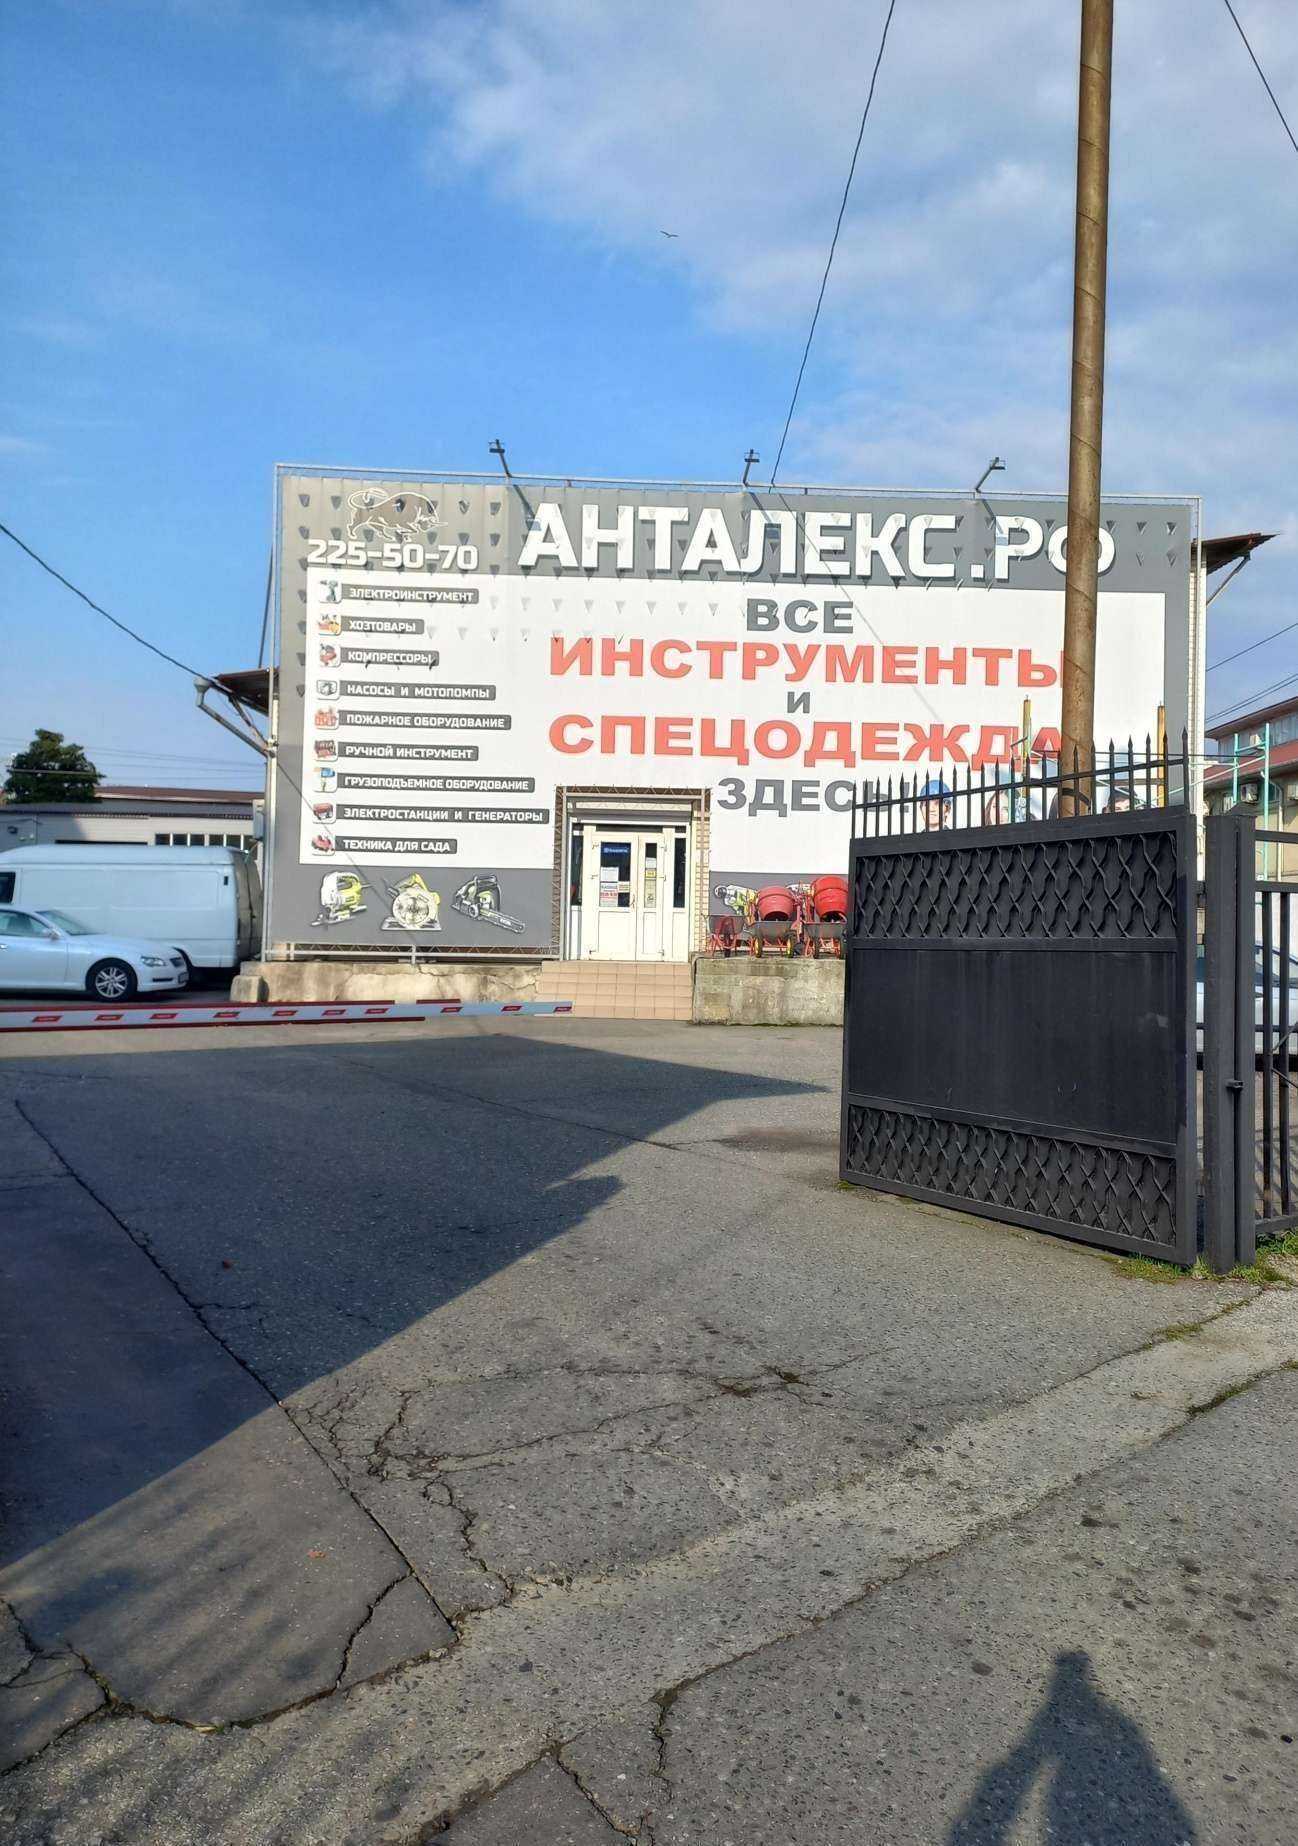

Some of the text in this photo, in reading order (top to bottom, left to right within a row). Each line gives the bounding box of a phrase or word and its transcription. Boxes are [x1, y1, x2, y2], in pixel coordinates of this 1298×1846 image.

[307, 539, 478, 570] 225-50-70
[349, 587, 474, 602] ЭЛЕКТРОИНСТРУМЕНТ
[746, 598, 854, 634] ВСЕ
[349, 619, 417, 633] ХОЗТОВАРЫ
[347, 650, 433, 664] КОМПРЕССОРЫ
[550, 636, 1065, 688] ИНСТРУМЕНТЫ
[347, 684, 490, 699] НАСОСЫ И МОТОПОМПЫ
[786, 691, 811, 714] И
[346, 713, 505, 729] ПОЖАРНОЕ ОБОРУДОВАНИЕ
[548, 714, 1062, 772] СПЕЦОДЕЖДА
[345, 745, 474, 760] РУЧНОЙ ИНСТРУМЕНТ
[344, 776, 529, 792] ГРУЗОПОДЪЕМНОЕ ОБОРУДОВАНИЕ
[343, 807, 543, 822] ЭЛЕКТРОСТАНЦИИ И ГЕНЕРАТОРЫ
[343, 839, 450, 853] ТЕХНИКА ДЛЯ САДА
